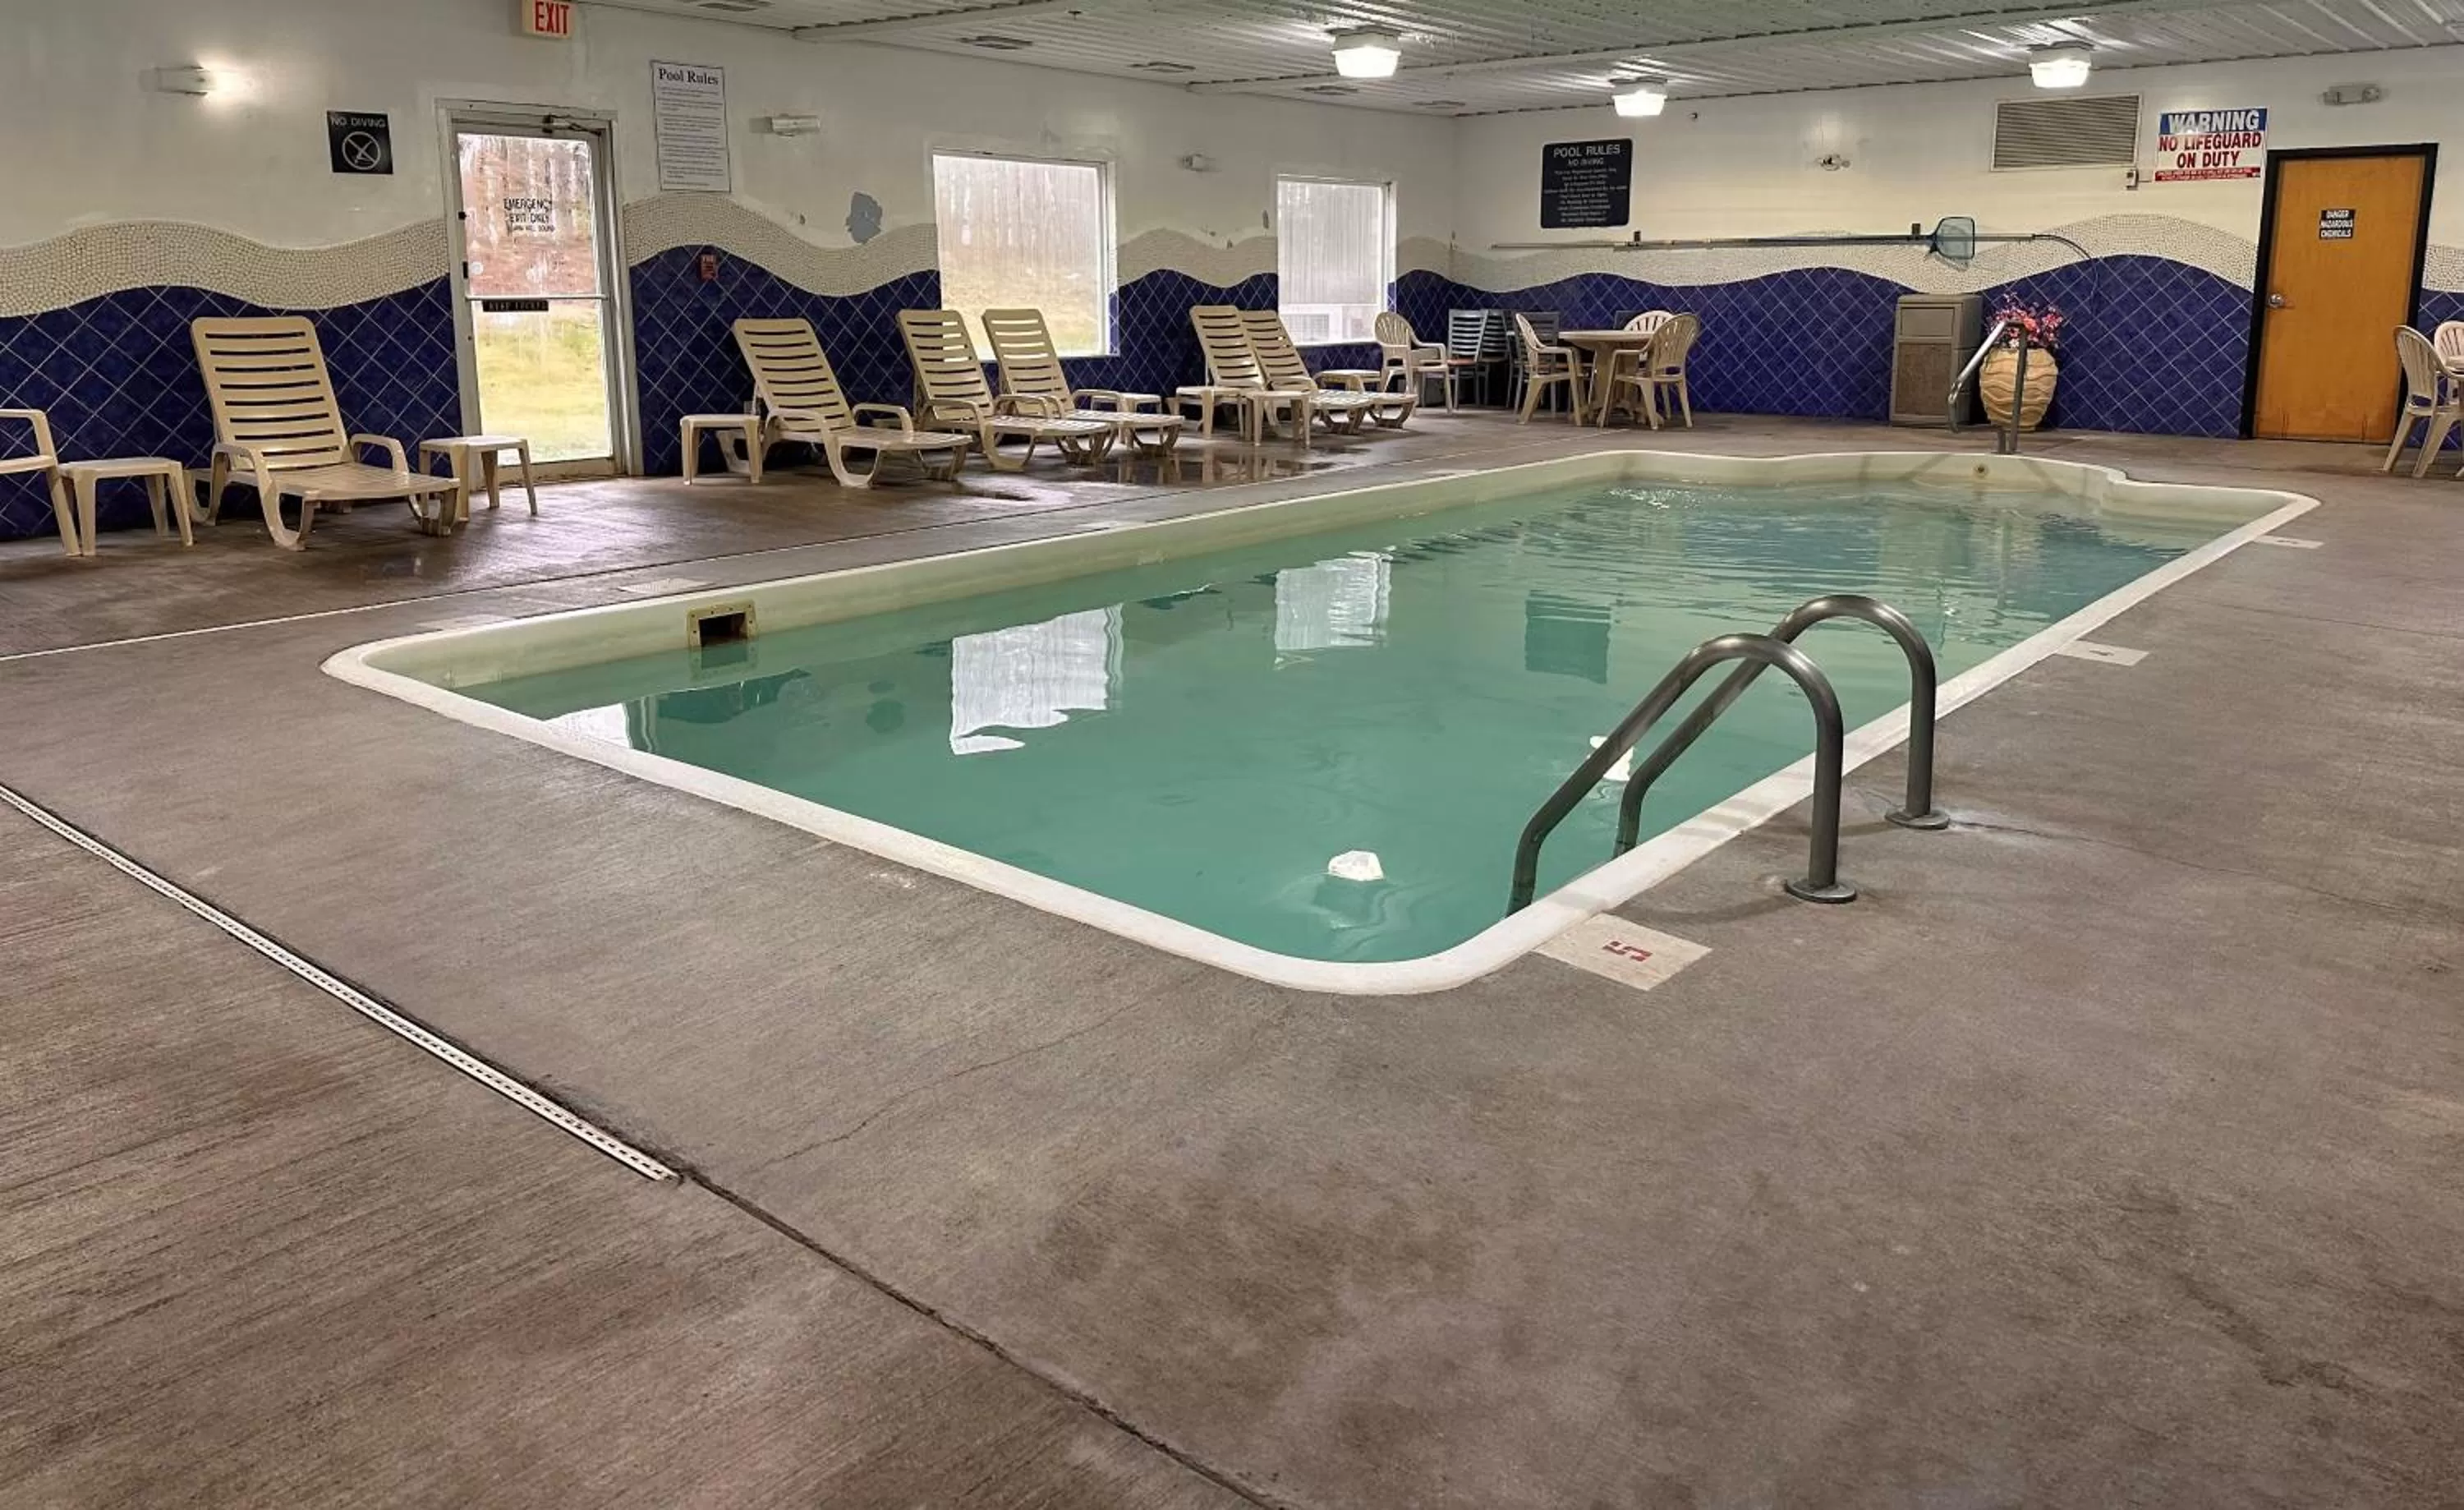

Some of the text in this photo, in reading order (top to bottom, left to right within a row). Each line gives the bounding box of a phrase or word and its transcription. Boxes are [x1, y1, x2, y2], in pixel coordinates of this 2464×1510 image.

[535, 1, 570, 35] EXIT
[659, 68, 719, 85] Pool Rules
[330, 117, 386, 128] NO DIVING
[2168, 109, 2259, 132] WARNING
[2158, 132, 2261, 151] NO LIFEGUARD
[1553, 144, 1620, 158] POOL RULES
[2177, 150, 2240, 168] ON DUTY
[503, 198, 552, 211] EMERGENCY
[1602, 941, 1653, 961] 5
